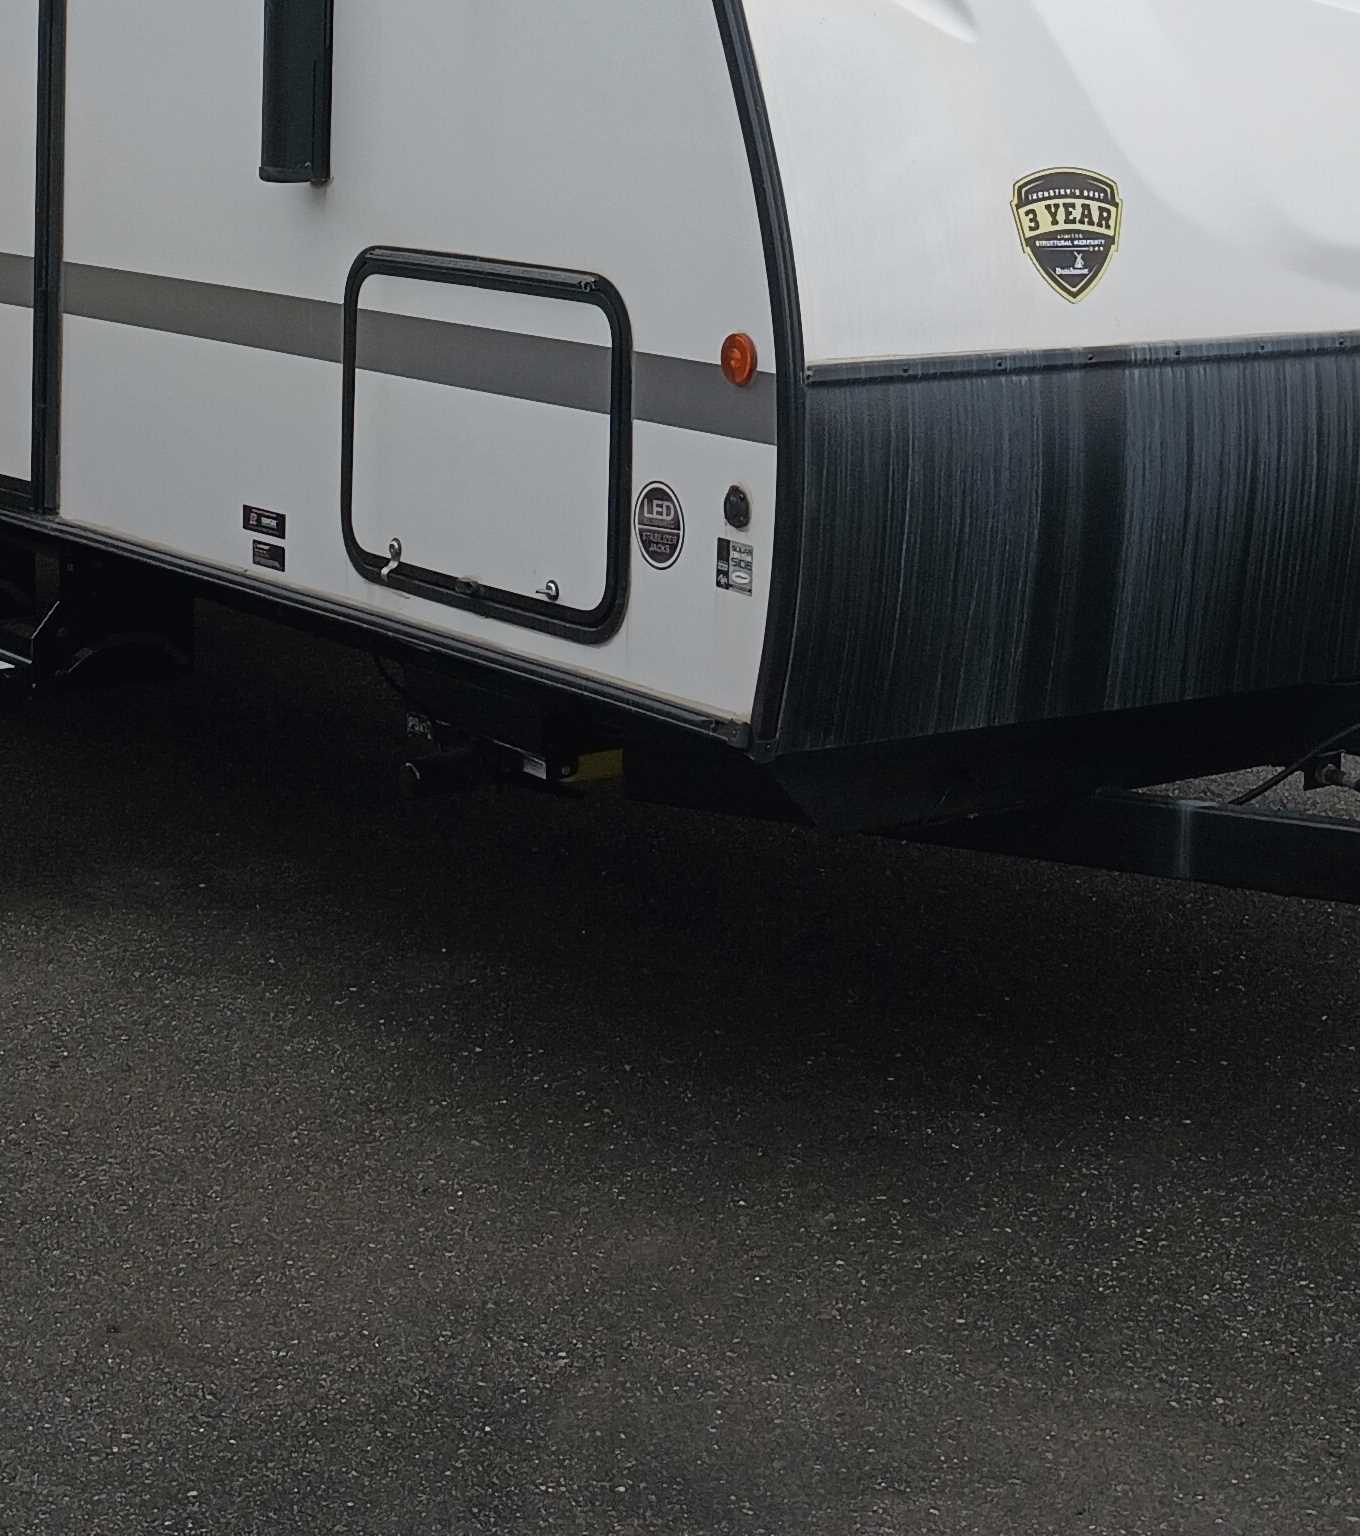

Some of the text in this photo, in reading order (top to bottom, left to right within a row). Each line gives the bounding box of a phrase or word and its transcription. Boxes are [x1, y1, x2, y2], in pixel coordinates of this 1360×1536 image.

[1024, 202, 1112, 232] 3 YEAR
[643, 497, 675, 521] LED
